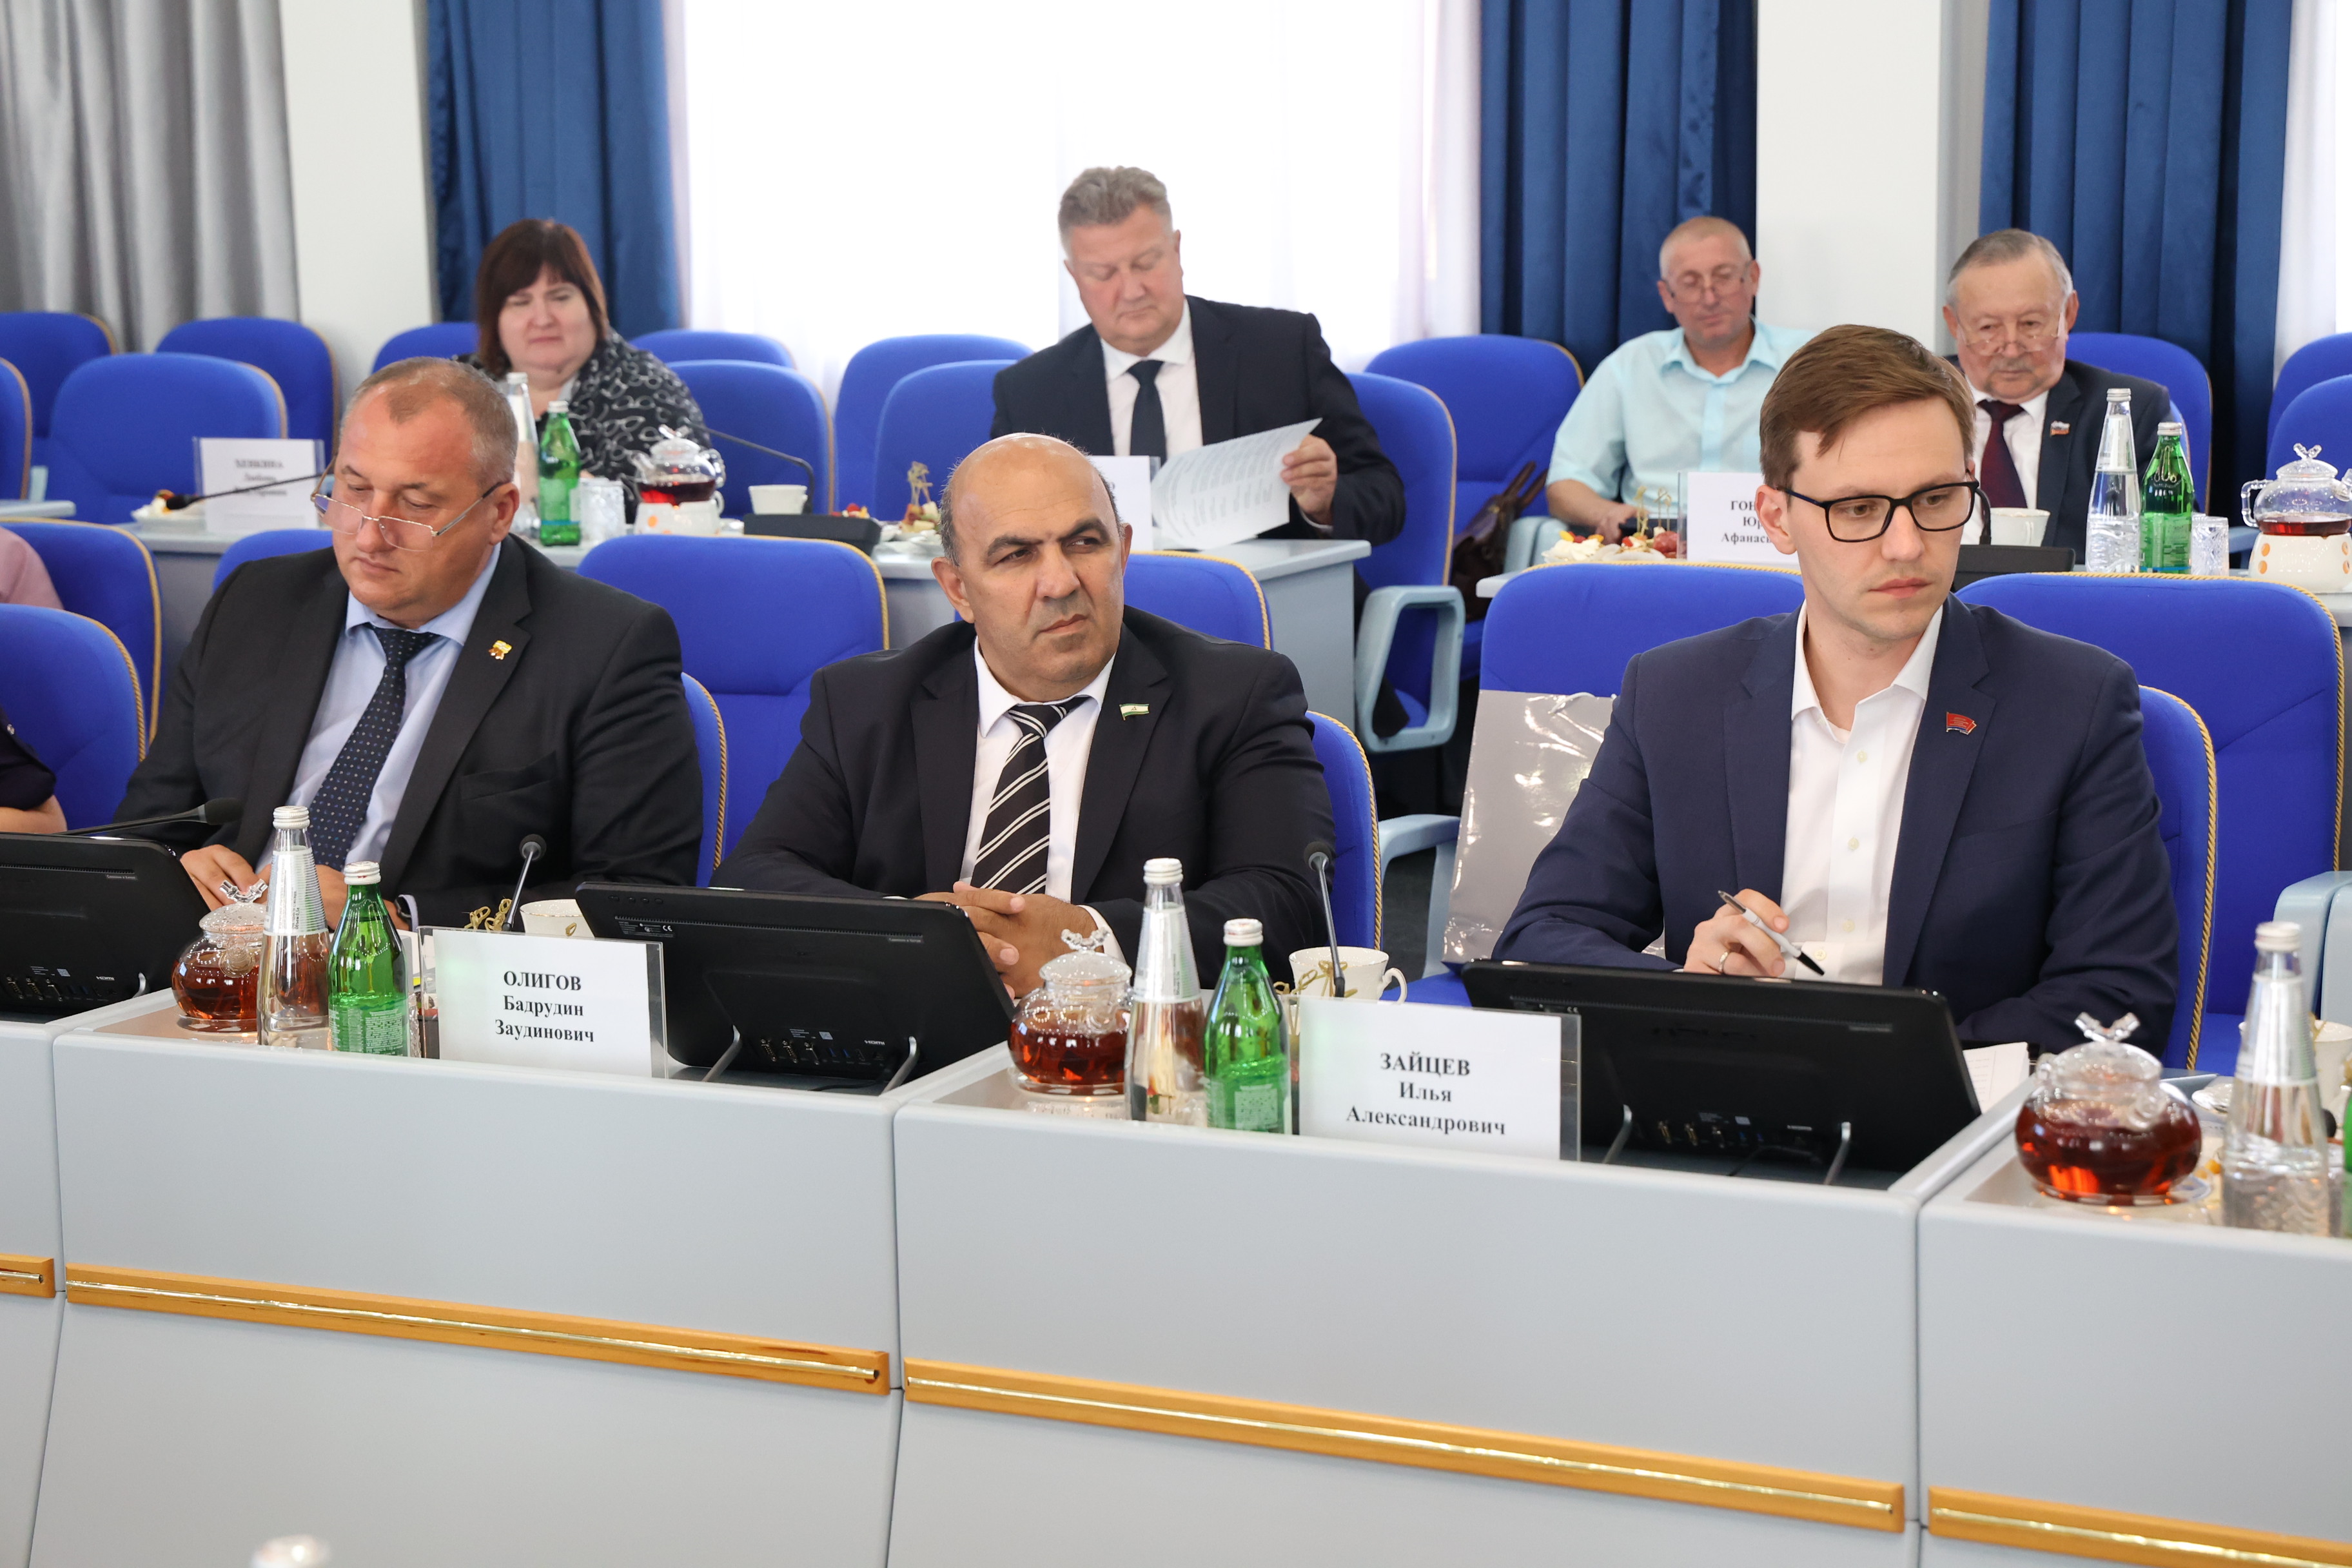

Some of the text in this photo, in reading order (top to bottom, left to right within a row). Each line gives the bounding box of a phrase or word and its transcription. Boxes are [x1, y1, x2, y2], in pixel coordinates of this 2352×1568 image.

[1730, 500, 1756, 511] ГОН
[1721, 533, 1771, 545] Афанась
[504, 970, 582, 991] ОЛИГОВ
[503, 995, 584, 1018] Бадрудин
[495, 1019, 594, 1043] Заудинович
[1380, 1050, 1471, 1077] ЗАЙЦЕВ
[1398, 1081, 1452, 1102] Илья
[1346, 1104, 1506, 1135] Александрович
